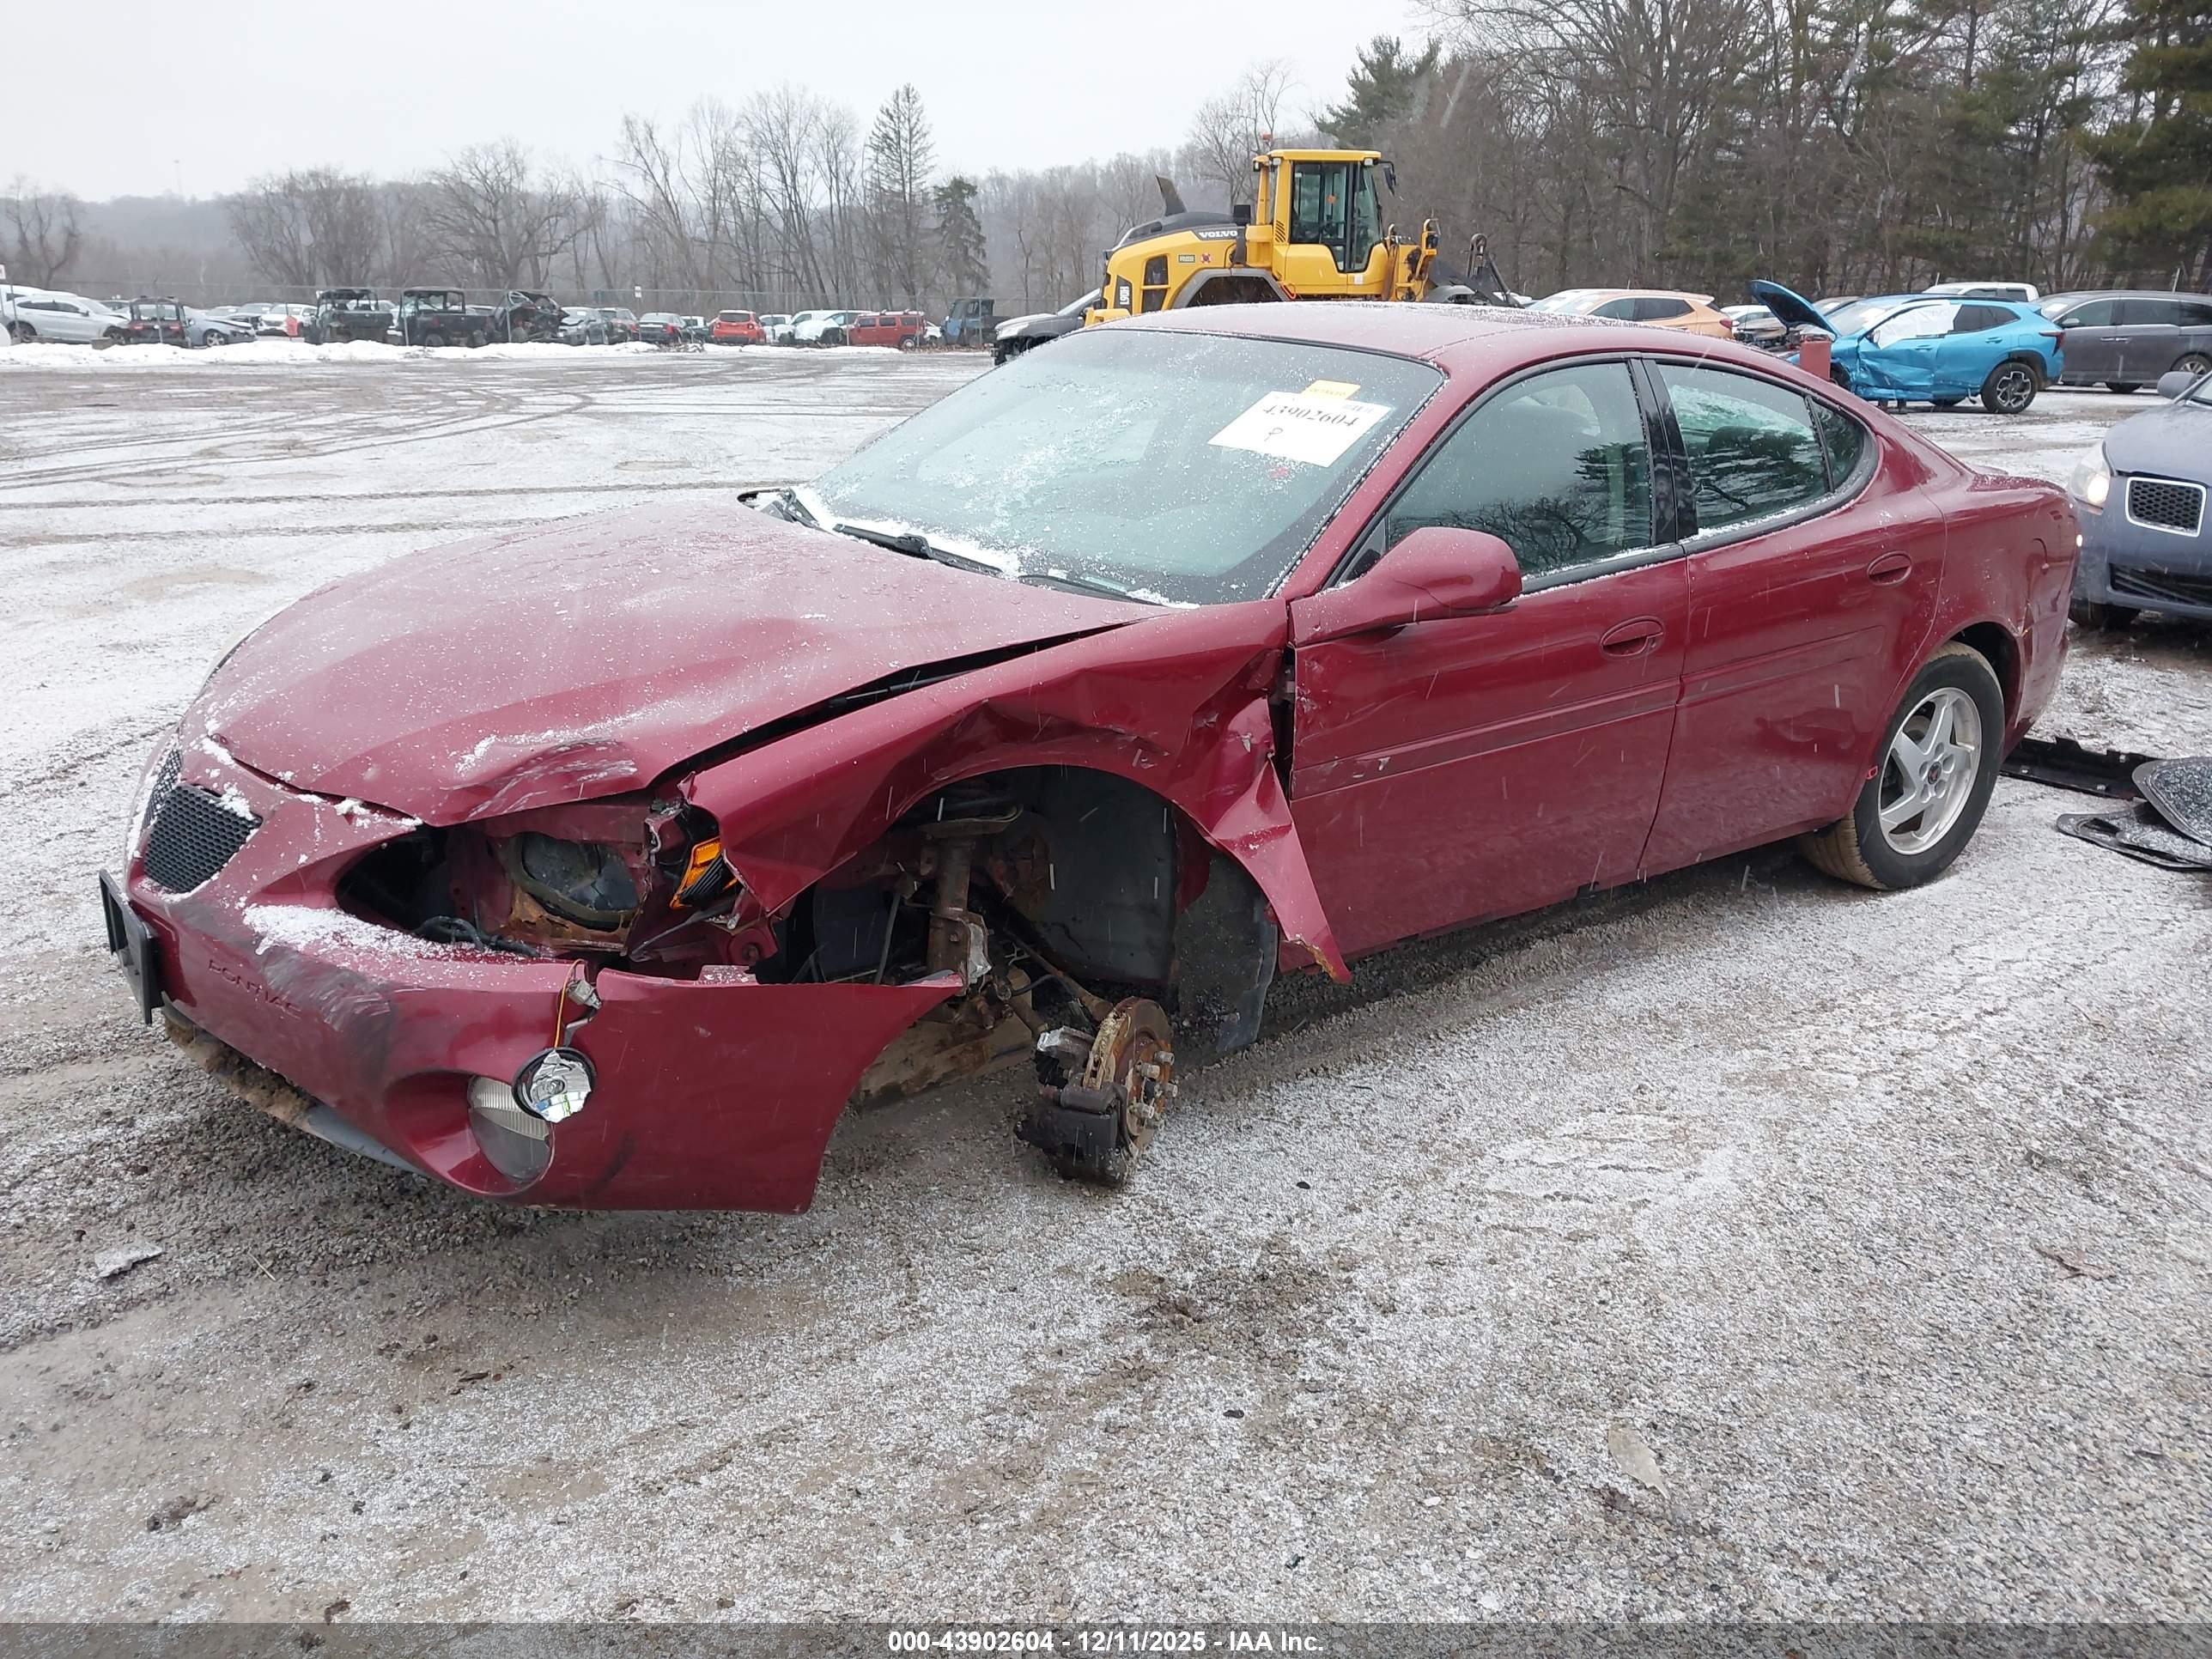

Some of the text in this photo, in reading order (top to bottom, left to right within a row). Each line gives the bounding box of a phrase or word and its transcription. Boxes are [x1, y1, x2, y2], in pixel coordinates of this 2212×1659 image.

[1199, 230, 1238, 239] VOLVO
[1263, 404, 1359, 427] 43902604
[208, 959, 301, 1020] PONTIAC
